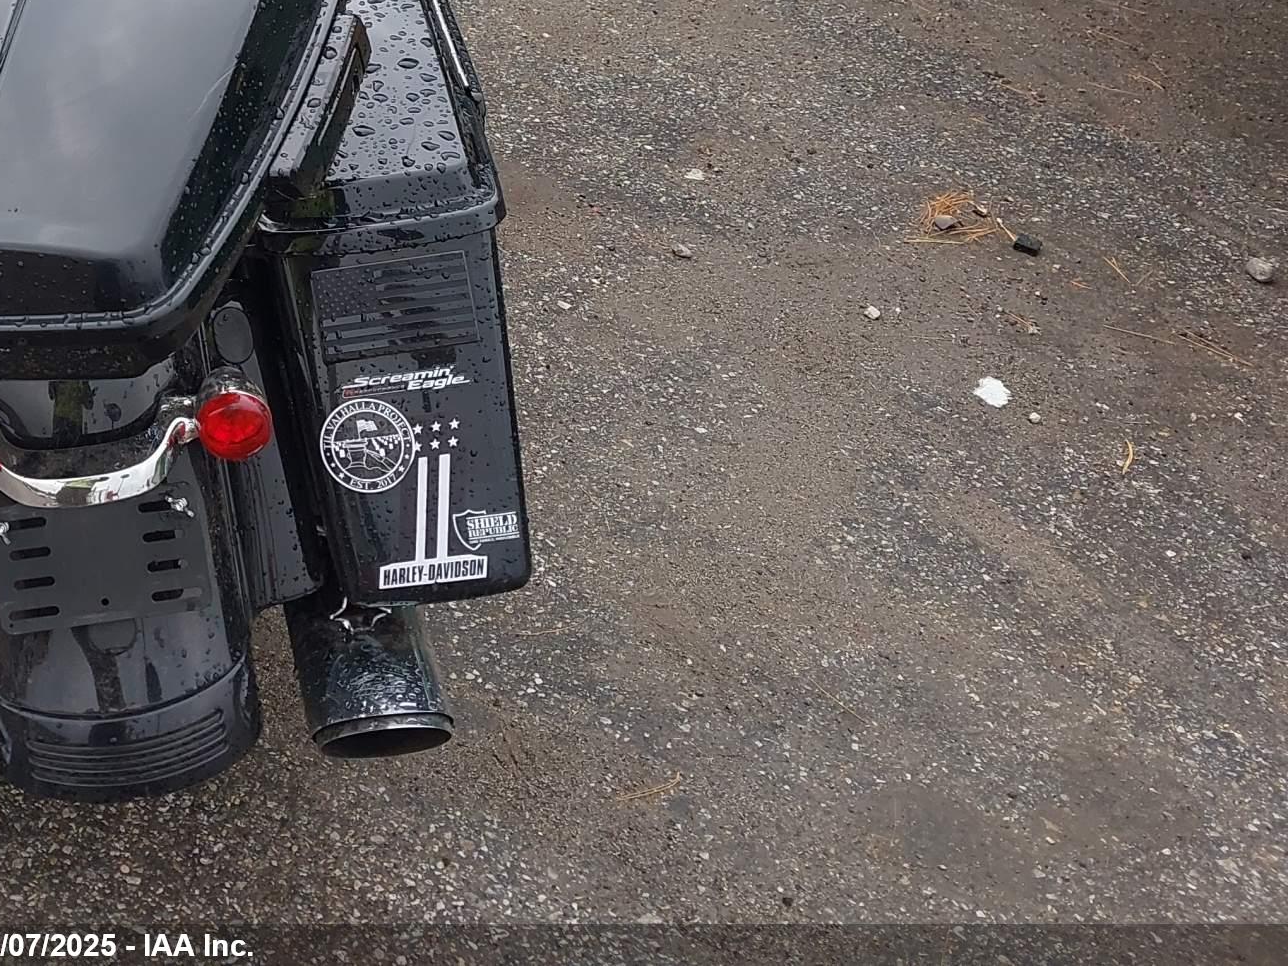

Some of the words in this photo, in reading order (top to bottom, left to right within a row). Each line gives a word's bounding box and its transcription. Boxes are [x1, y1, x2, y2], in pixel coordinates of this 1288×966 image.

[407, 374, 470, 390] Eagle
[326, 401, 376, 431] VALHALLA
[377, 404, 412, 442] PROJECT
[349, 478, 374, 490] EST.
[377, 473, 397, 489] 2017
[467, 514, 518, 529] SHIELD
[468, 524, 519, 537] REPUBLIC
[383, 558, 485, 586] HARLEY-DAVIDSON
